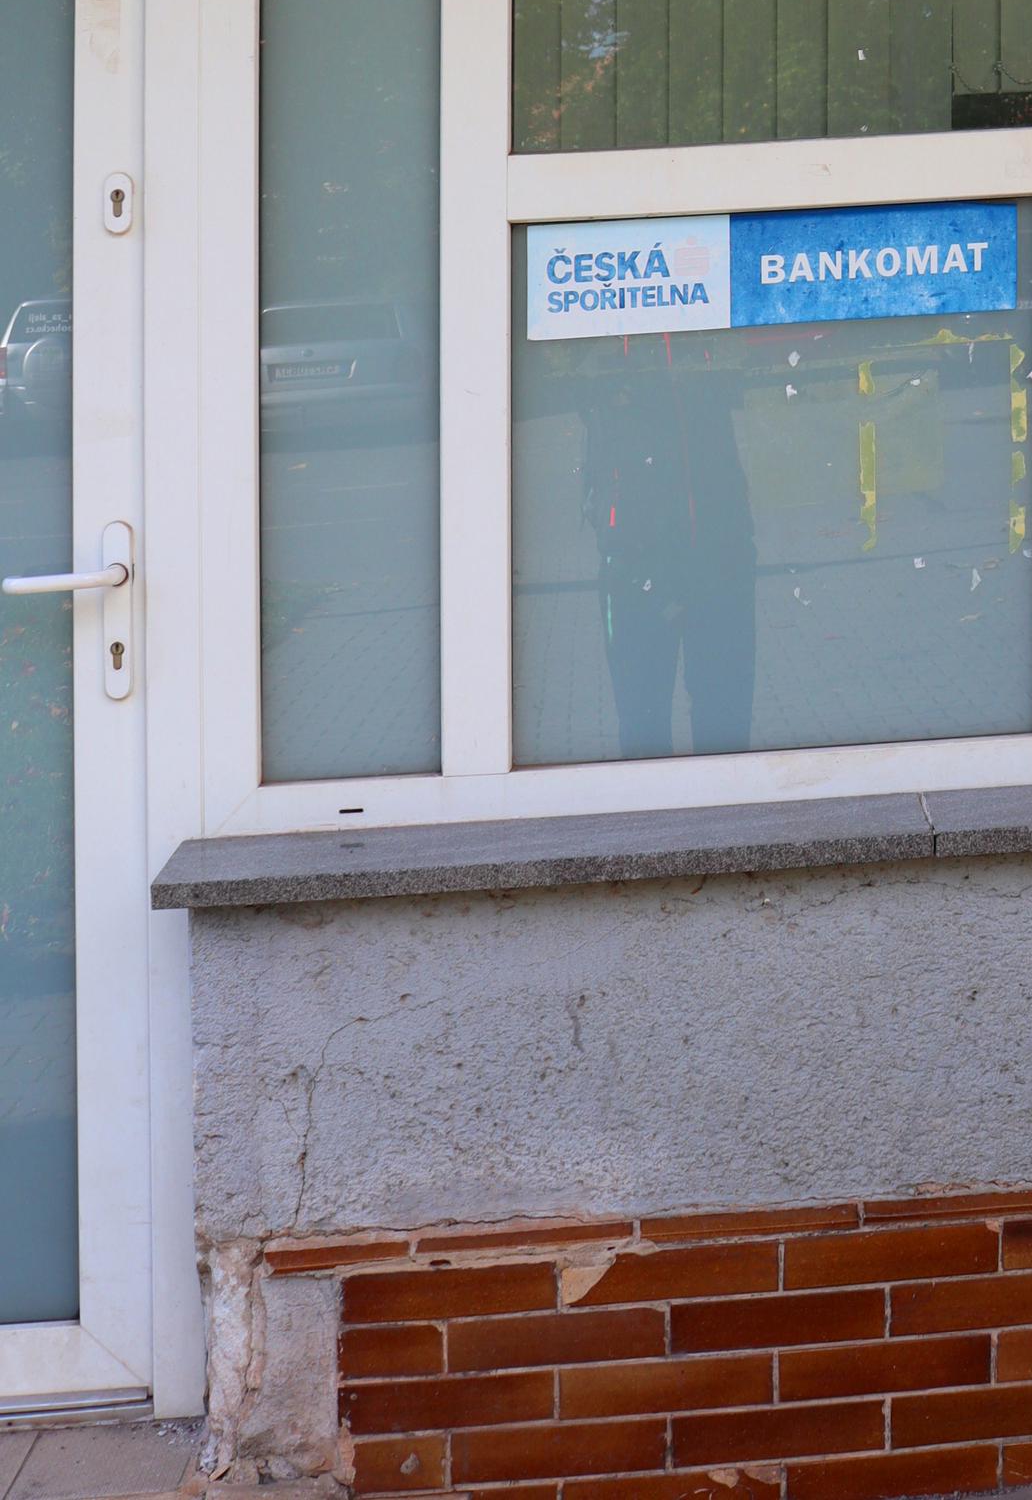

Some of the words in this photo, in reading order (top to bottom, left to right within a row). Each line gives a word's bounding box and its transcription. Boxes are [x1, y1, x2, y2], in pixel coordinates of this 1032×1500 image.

[546, 241, 671, 285] ČESKÁ
[760, 241, 989, 285] BANKOMAT
[546, 282, 710, 314] SPOŘITELNA
